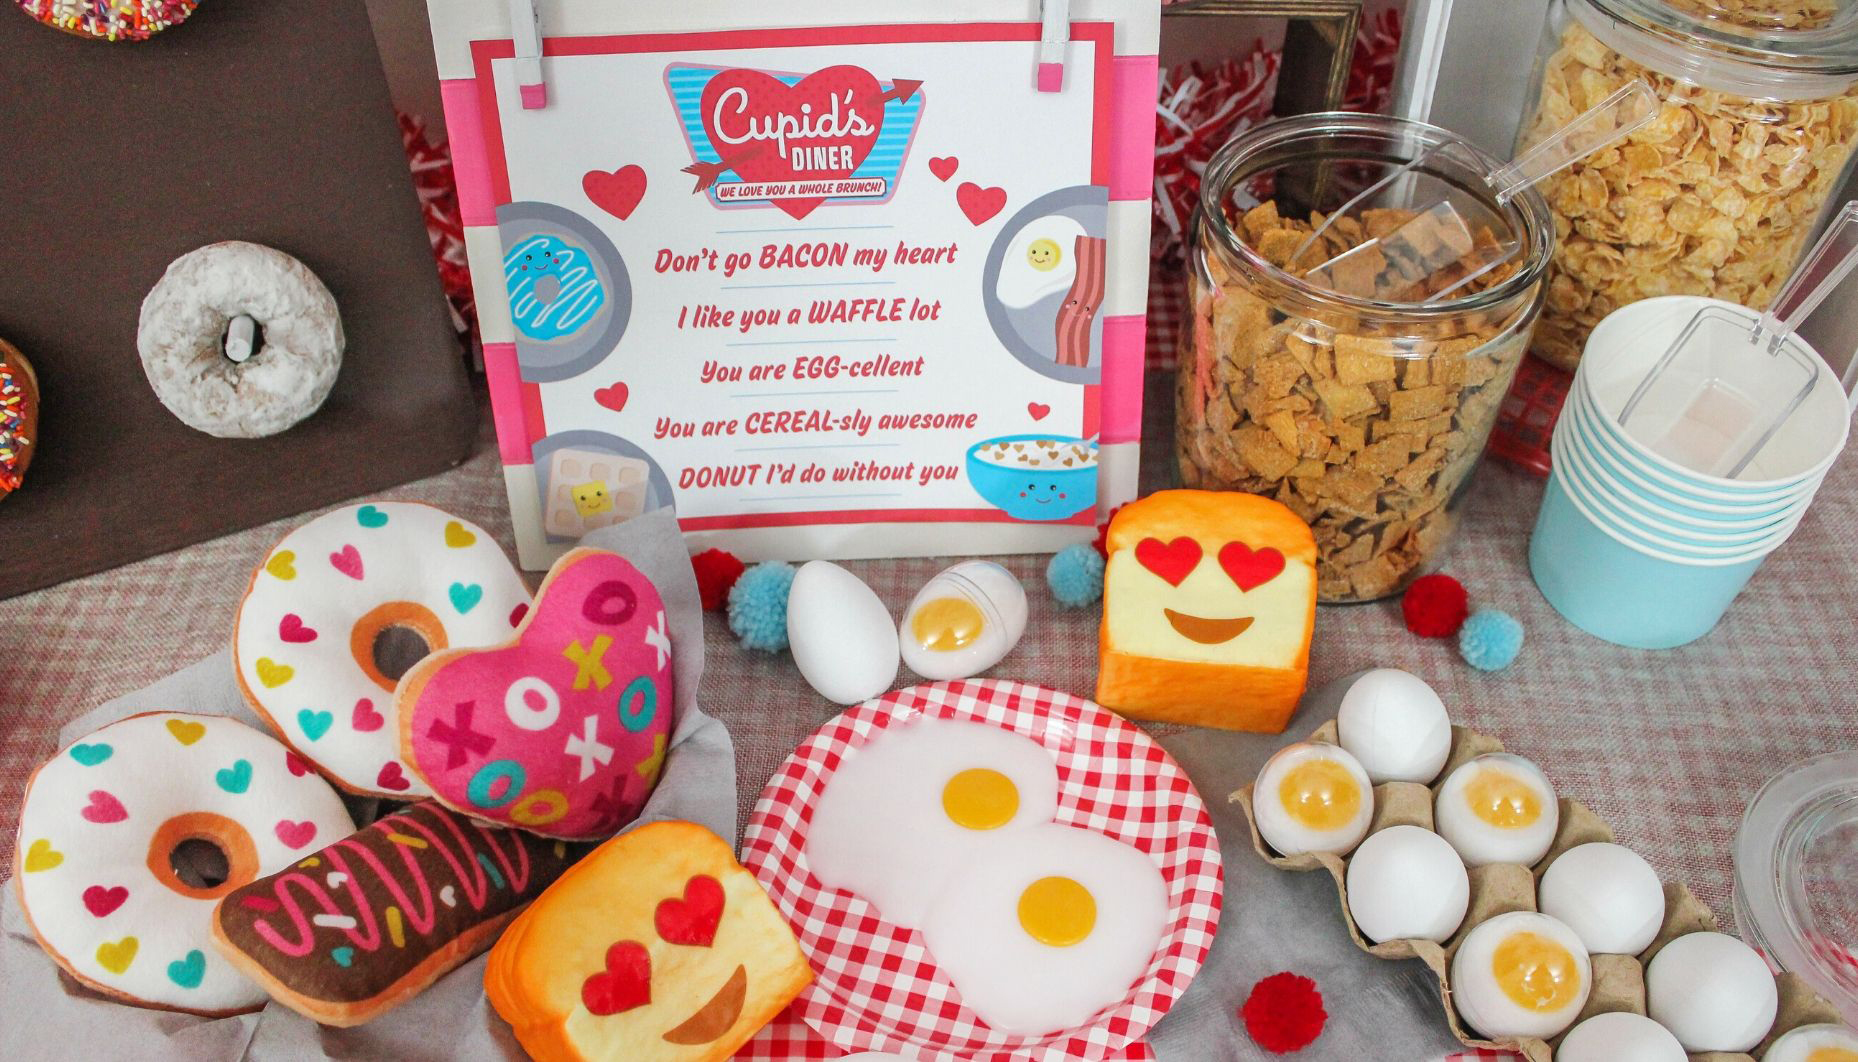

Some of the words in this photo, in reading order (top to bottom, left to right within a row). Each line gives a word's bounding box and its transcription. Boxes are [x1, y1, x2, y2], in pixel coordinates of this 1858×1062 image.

[713, 87, 875, 160] Cupid's
[792, 145, 854, 171] DINER
[720, 187, 735, 198] WE
[738, 185, 763, 197] LOVE
[766, 184, 786, 196] YOU
[788, 183, 796, 194] A
[799, 182, 833, 195] WHOLE
[836, 181, 882, 194] BRUNCH!
[655, 248, 718, 274] Don't
[724, 252, 752, 278] go
[758, 242, 849, 270] BACON
[853, 248, 888, 273] my
[893, 240, 958, 265] heart
[677, 306, 688, 329] I
[692, 304, 735, 329] like
[739, 309, 781, 334] you
[787, 308, 802, 326] a
[807, 298, 907, 325] WAFFLE
[909, 297, 942, 322] lot
[700, 360, 742, 384] You
[748, 365, 787, 382] are
[791, 354, 925, 380] EGG-cellent
[654, 416, 696, 440] You
[701, 420, 738, 436] are
[744, 409, 873, 438] CEREAL-sly
[877, 412, 978, 432] awesome
[678, 464, 762, 490] DONUT
[765, 463, 796, 485] I'd
[799, 463, 827, 484] do
[831, 460, 916, 483] without
[918, 465, 960, 487] you
